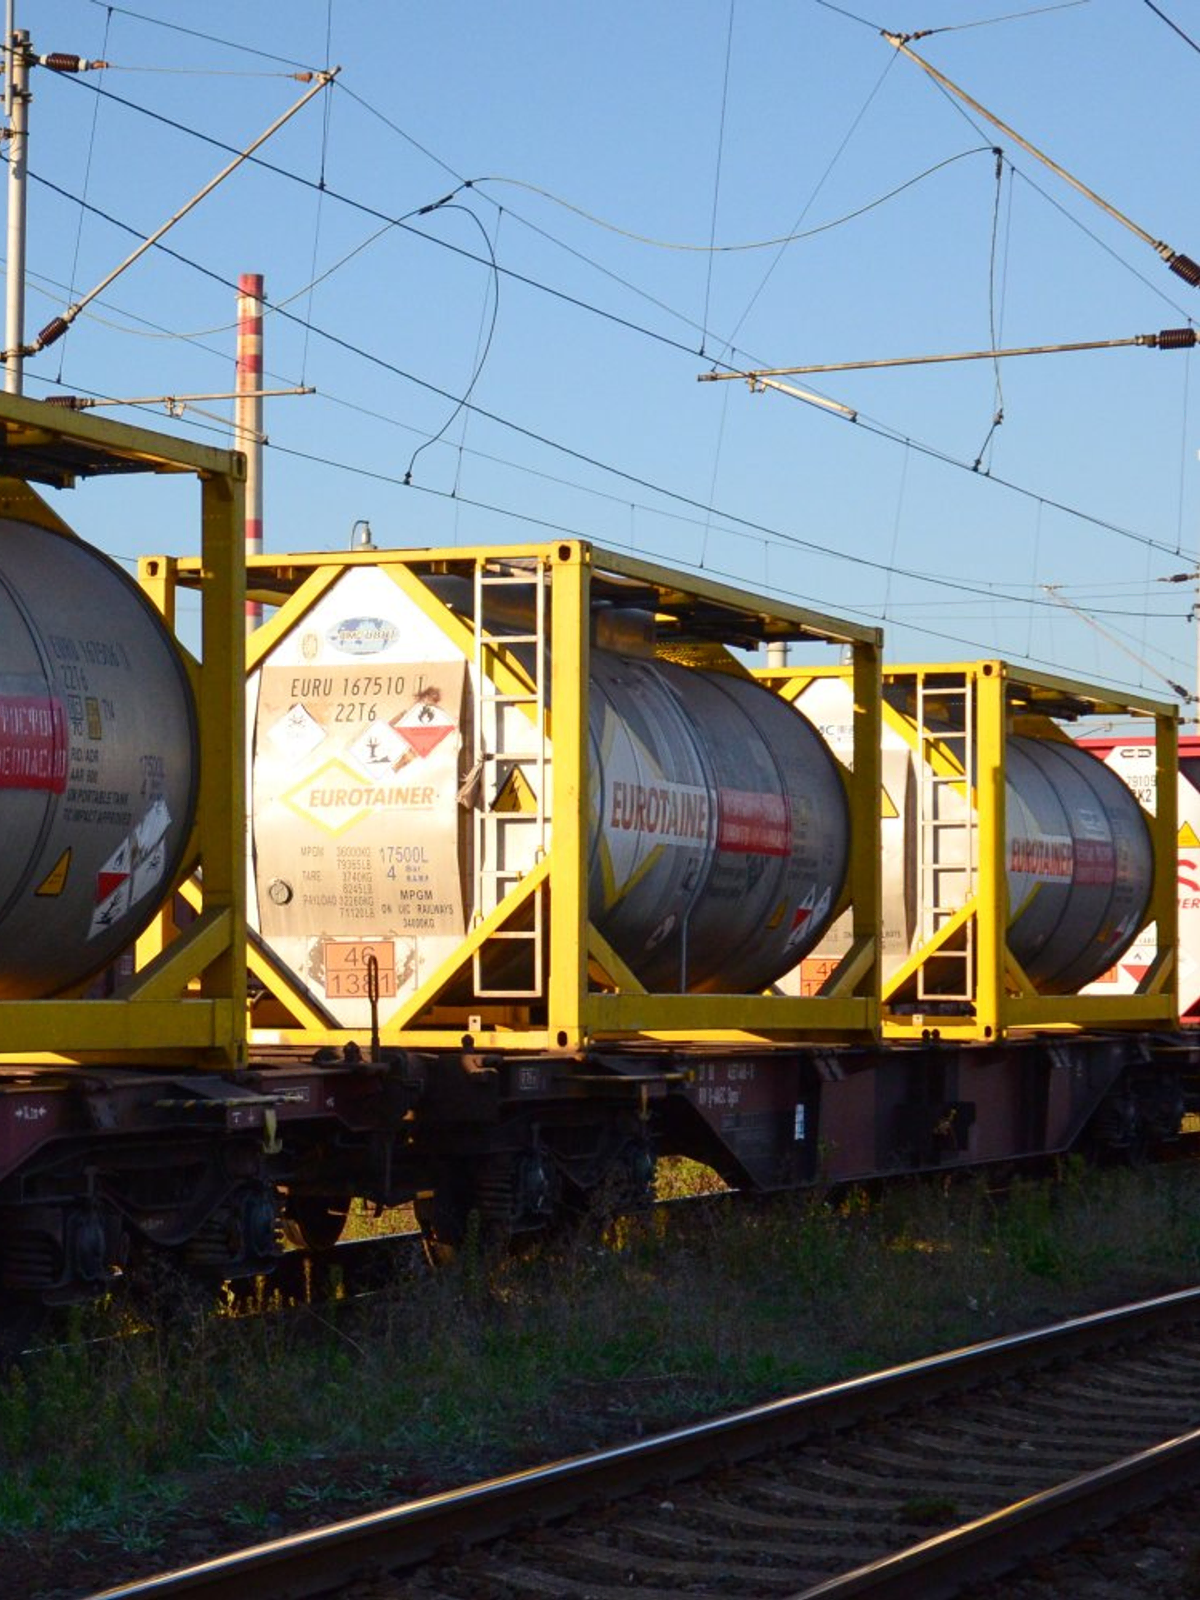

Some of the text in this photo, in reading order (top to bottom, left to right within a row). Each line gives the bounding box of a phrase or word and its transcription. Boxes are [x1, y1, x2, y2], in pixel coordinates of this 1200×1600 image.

[291, 678, 332, 698] EURU
[343, 676, 404, 698] 167510
[335, 702, 378, 722] 22T6
[309, 787, 435, 807] EUROTAINER
[379, 847, 429, 864] 17500L
[386, 865, 397, 882] 4
[400, 890, 433, 901] MPGM
[344, 946, 375, 967] 46
